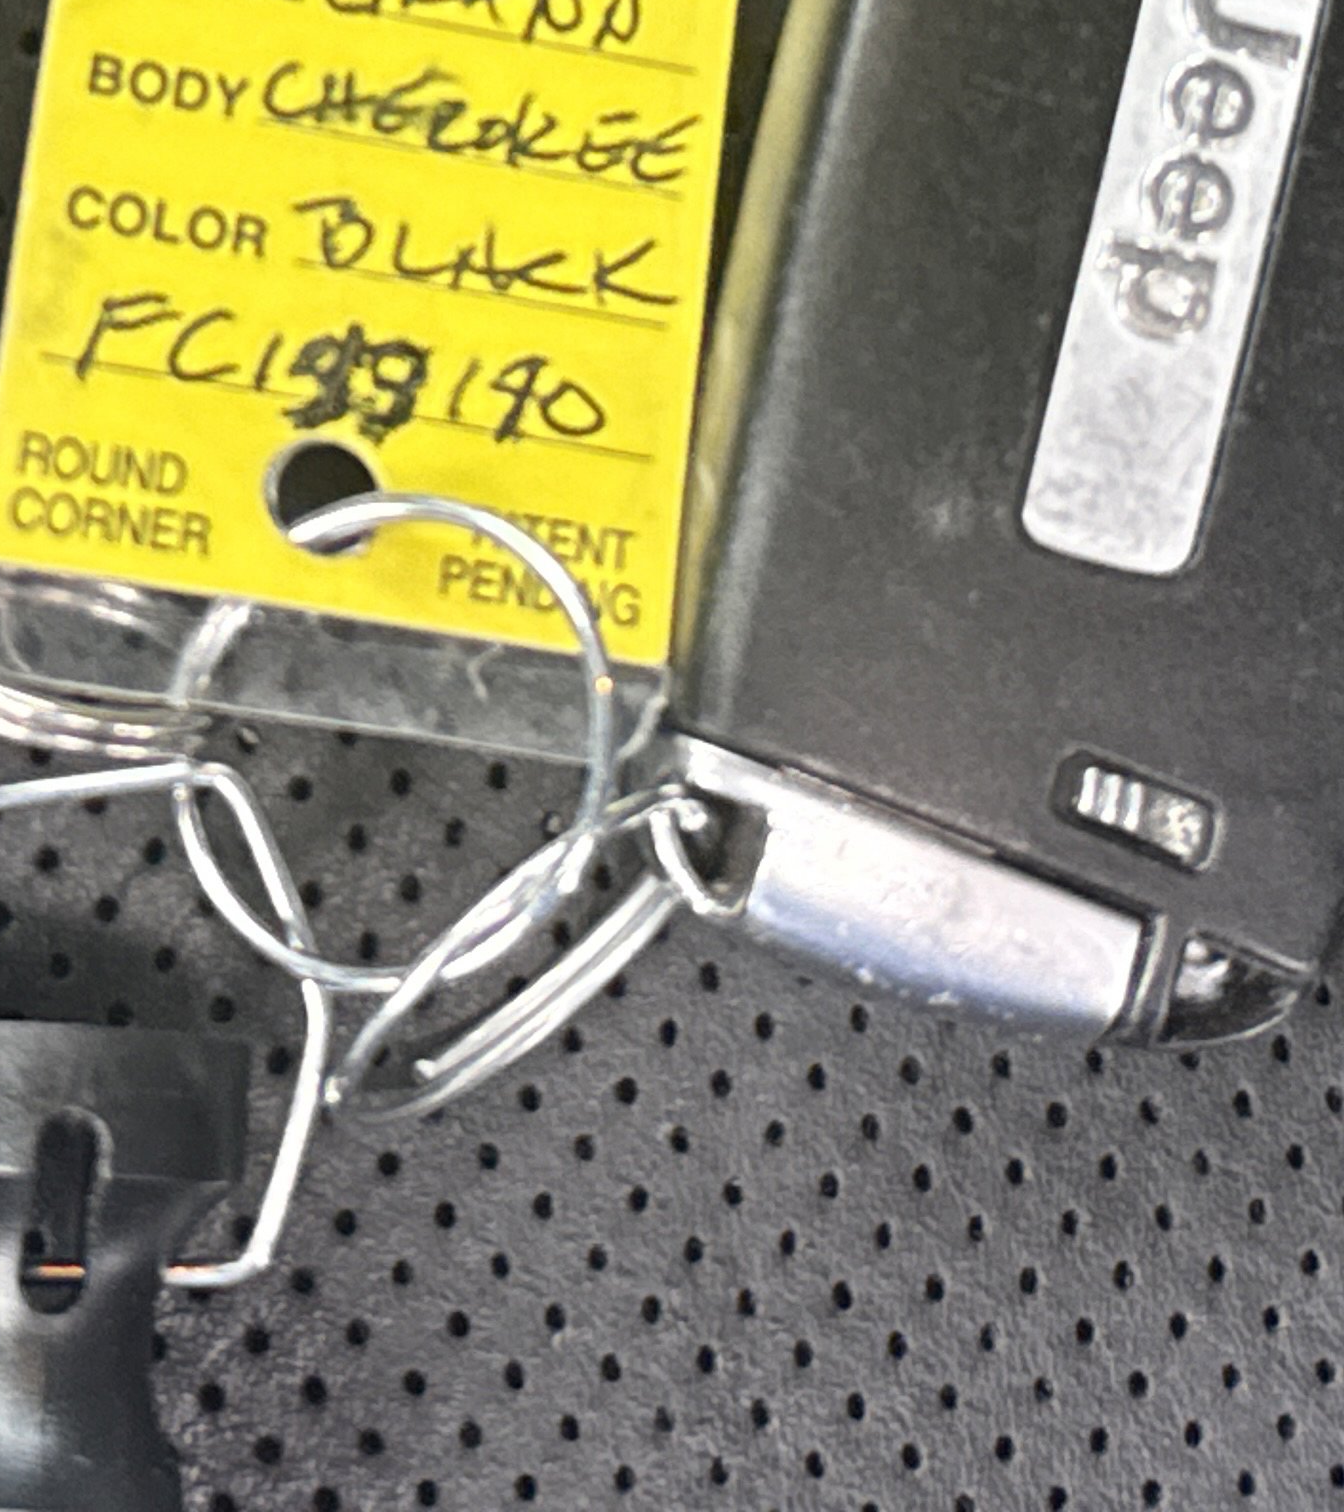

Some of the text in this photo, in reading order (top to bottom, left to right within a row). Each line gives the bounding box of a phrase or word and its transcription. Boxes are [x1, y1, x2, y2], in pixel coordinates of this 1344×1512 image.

[87, 52, 250, 119] BODY
[262, 61, 702, 184] CHEROKEE
[66, 185, 268, 258] COLOR
[292, 195, 679, 307] BLACK
[17, 429, 189, 494] ROUND
[8, 487, 212, 557] CORNER
